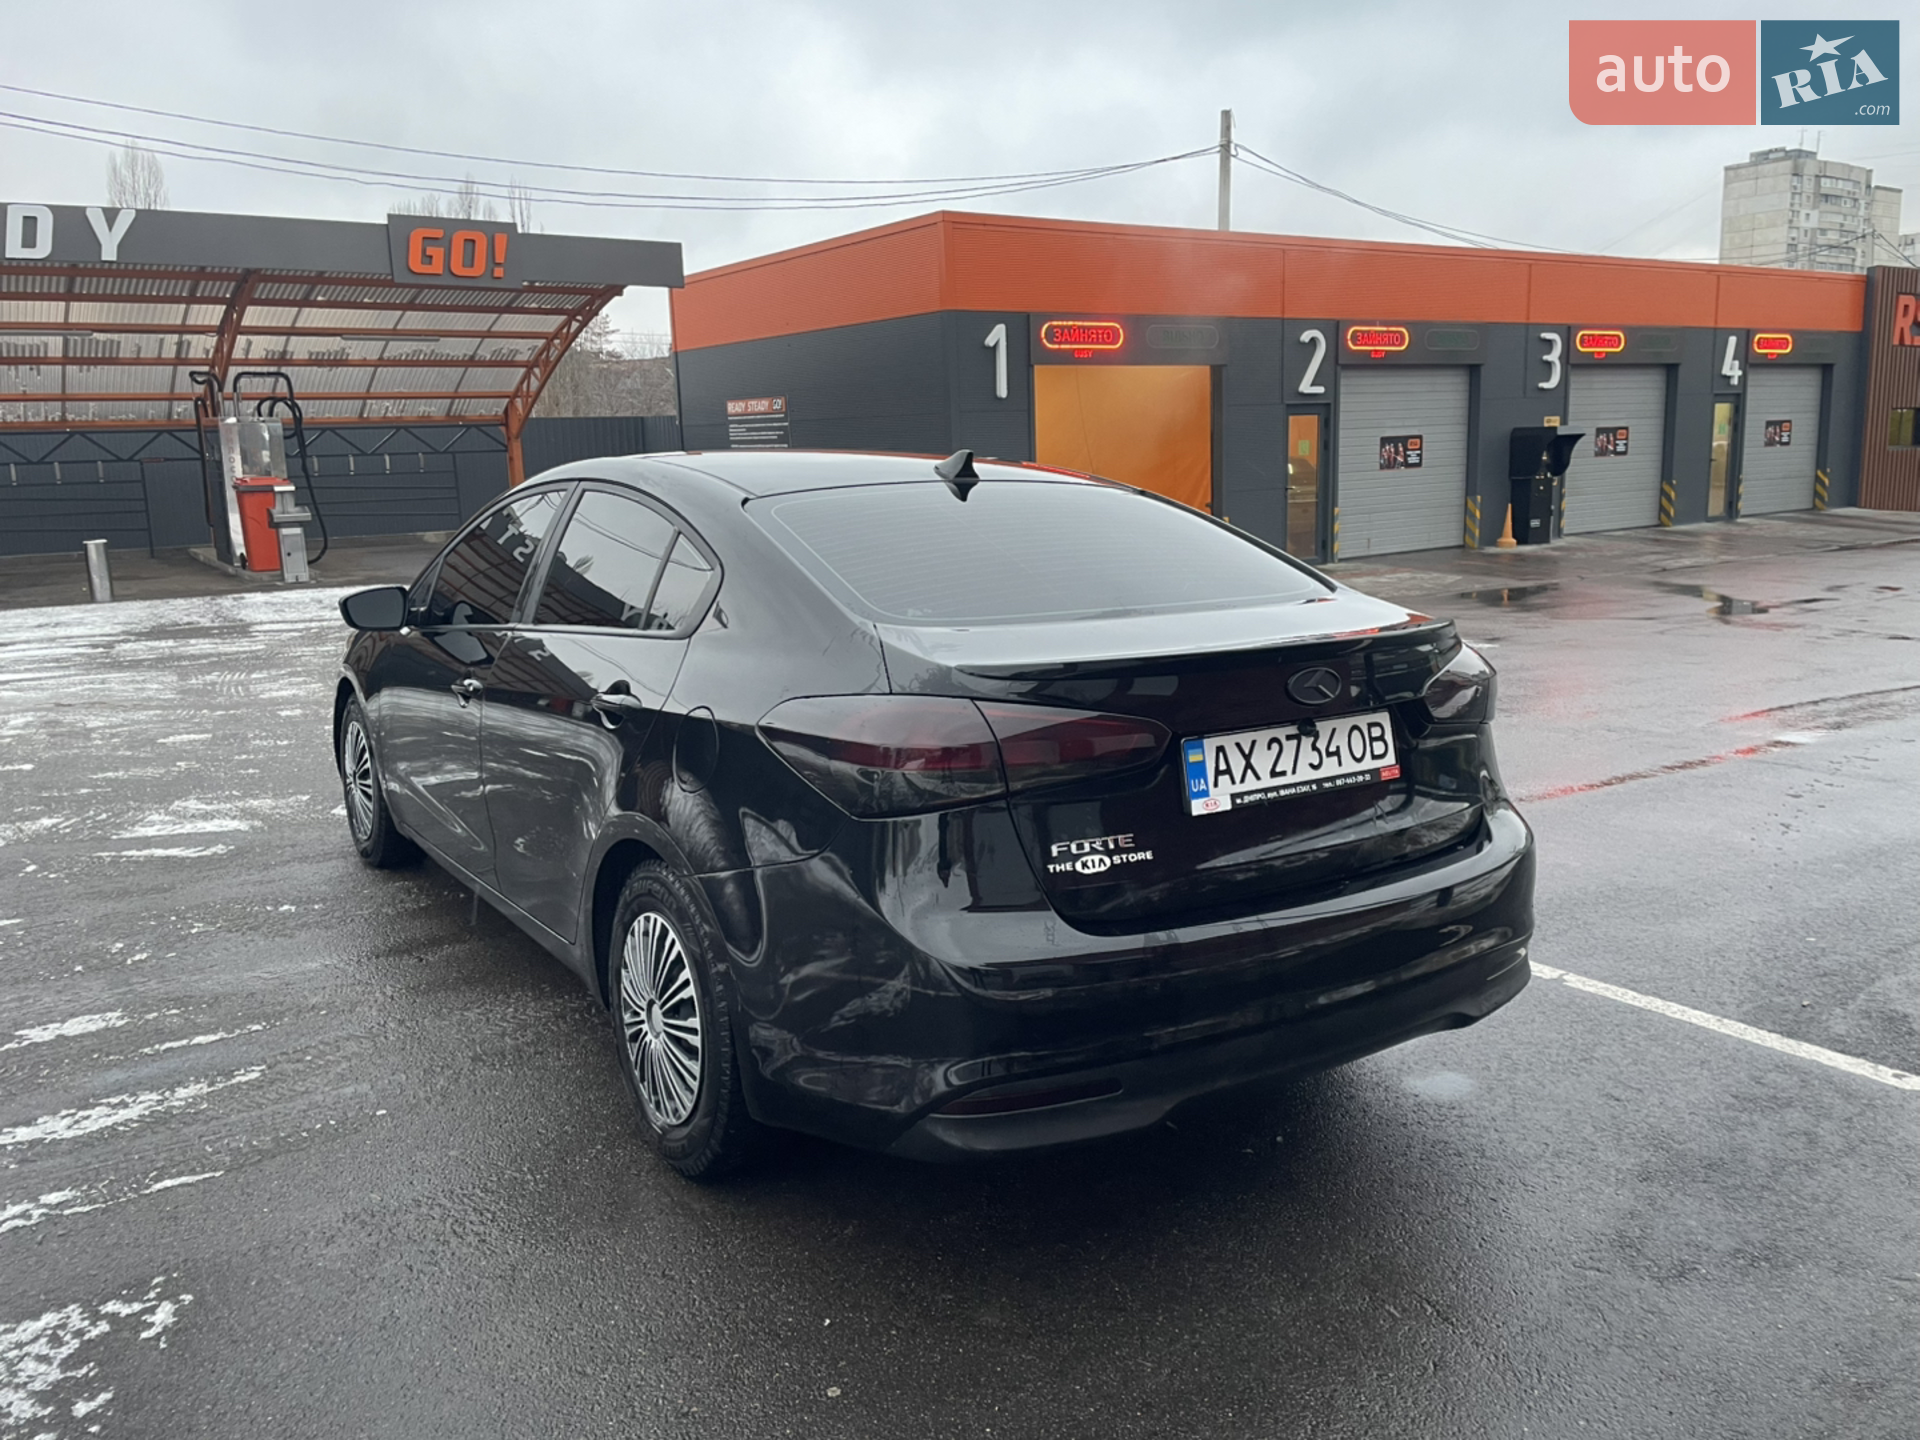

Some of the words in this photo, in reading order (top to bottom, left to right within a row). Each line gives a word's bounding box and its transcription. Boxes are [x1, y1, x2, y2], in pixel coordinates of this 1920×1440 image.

[408, 227, 509, 279] GO!
[1052, 325, 1113, 343] ЗАЙНЯТО
[1356, 330, 1401, 345] ЗАЙНЯТО
[983, 323, 1009, 399] 1
[1297, 328, 1327, 395] 2
[1537, 332, 1562, 390] 3
[1721, 335, 1743, 386] 4
[1213, 739, 1262, 789] AX
[1267, 727, 1343, 779] 2734
[1347, 721, 1389, 764] OB
[1191, 778, 1208, 792] UA
[1047, 861, 1074, 874] THE
[1079, 857, 1108, 871] KIA
[1111, 850, 1154, 865] STORE
[1050, 833, 1136, 858] FORTE
